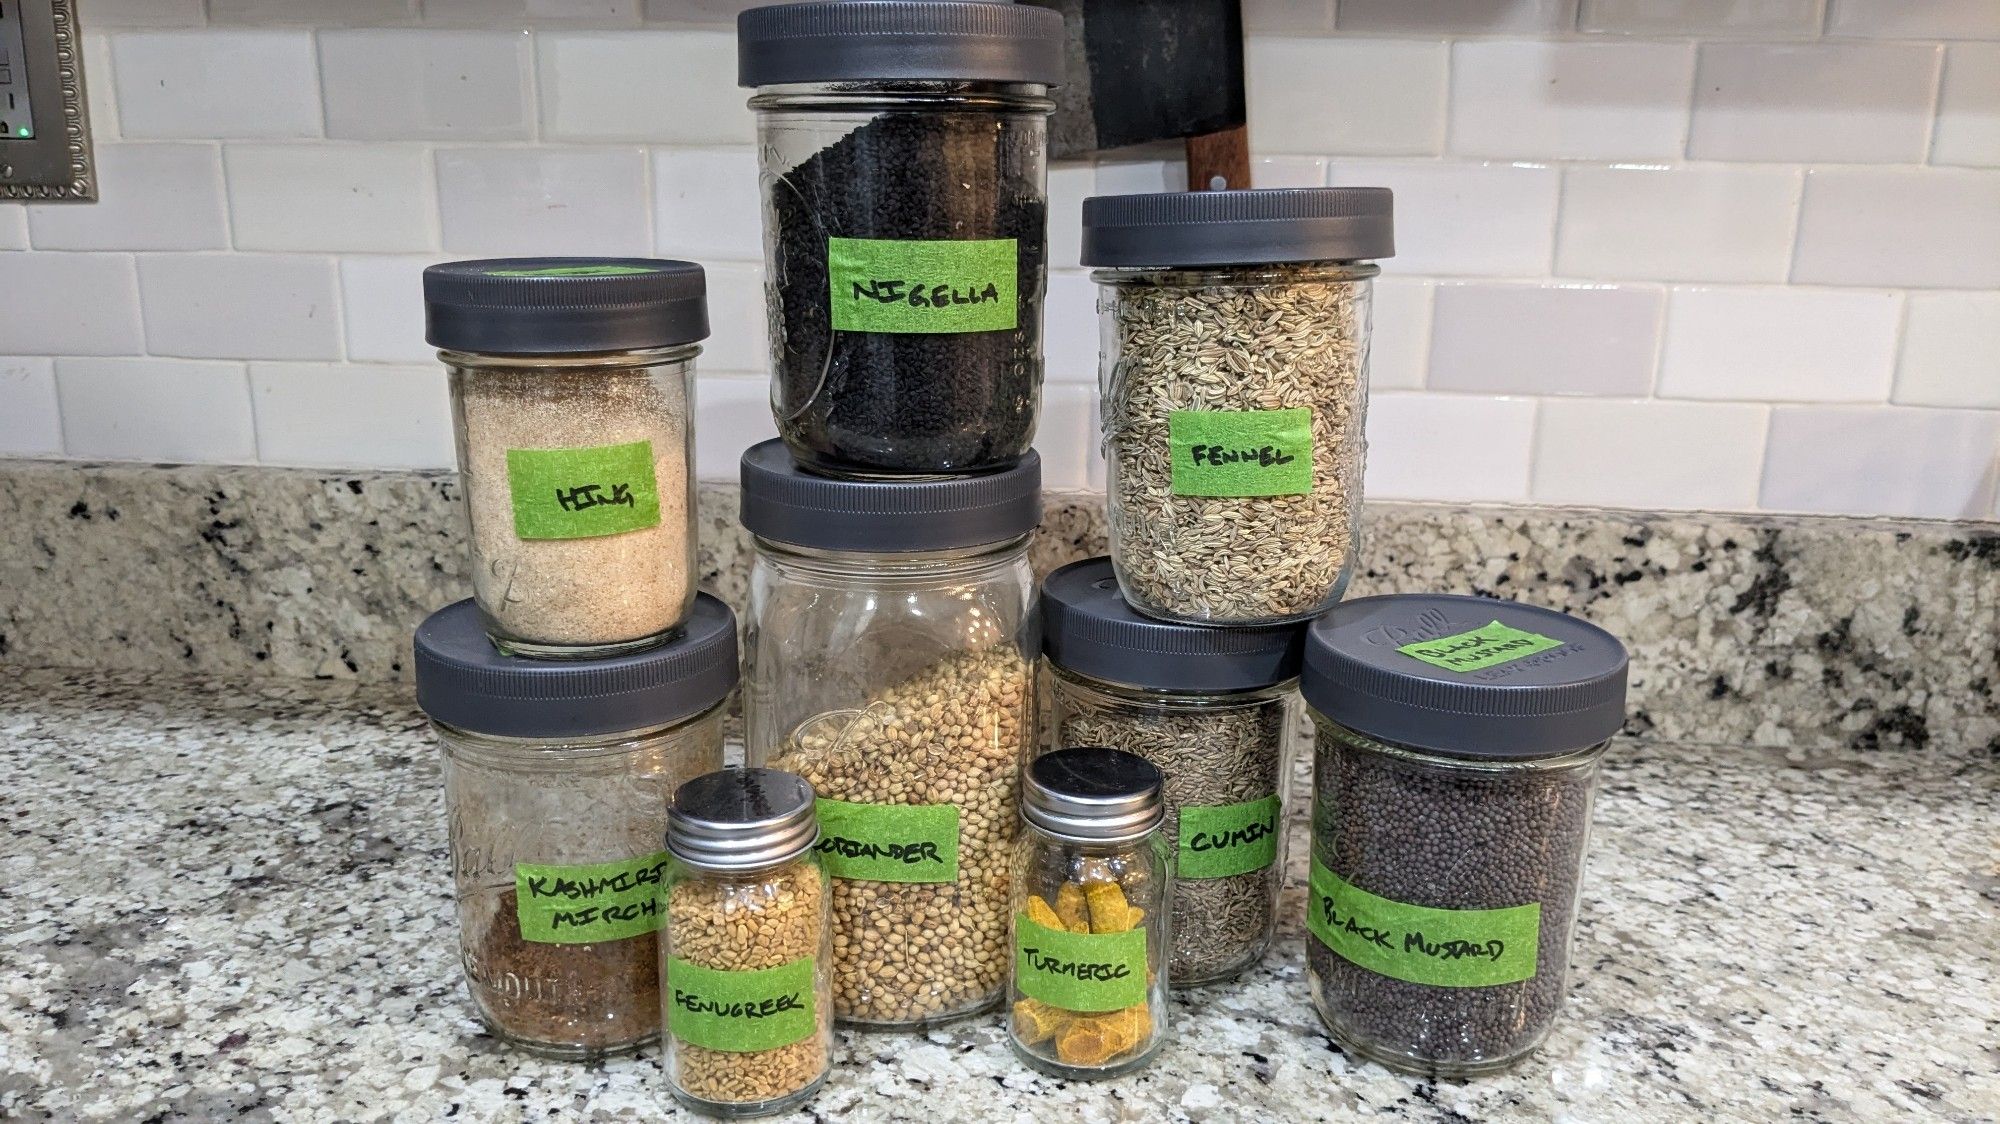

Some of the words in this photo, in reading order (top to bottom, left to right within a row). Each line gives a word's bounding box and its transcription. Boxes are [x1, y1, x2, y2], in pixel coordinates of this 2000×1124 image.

[853, 279, 998, 308] NIGELLA
[1191, 444, 1294, 467] FENNEL
[556, 483, 634, 512] HING
[1415, 636, 1500, 659] BLACK
[1445, 639, 1535, 667] MUSTARD
[1190, 815, 1274, 852] CUMIN
[528, 860, 667, 901] KASHMIRI
[1322, 896, 1395, 951] BLACK
[1404, 932, 1504, 962] MUSTARD
[1023, 948, 1130, 980] TURMERIC
[675, 990, 804, 1019] FENUGREEK
